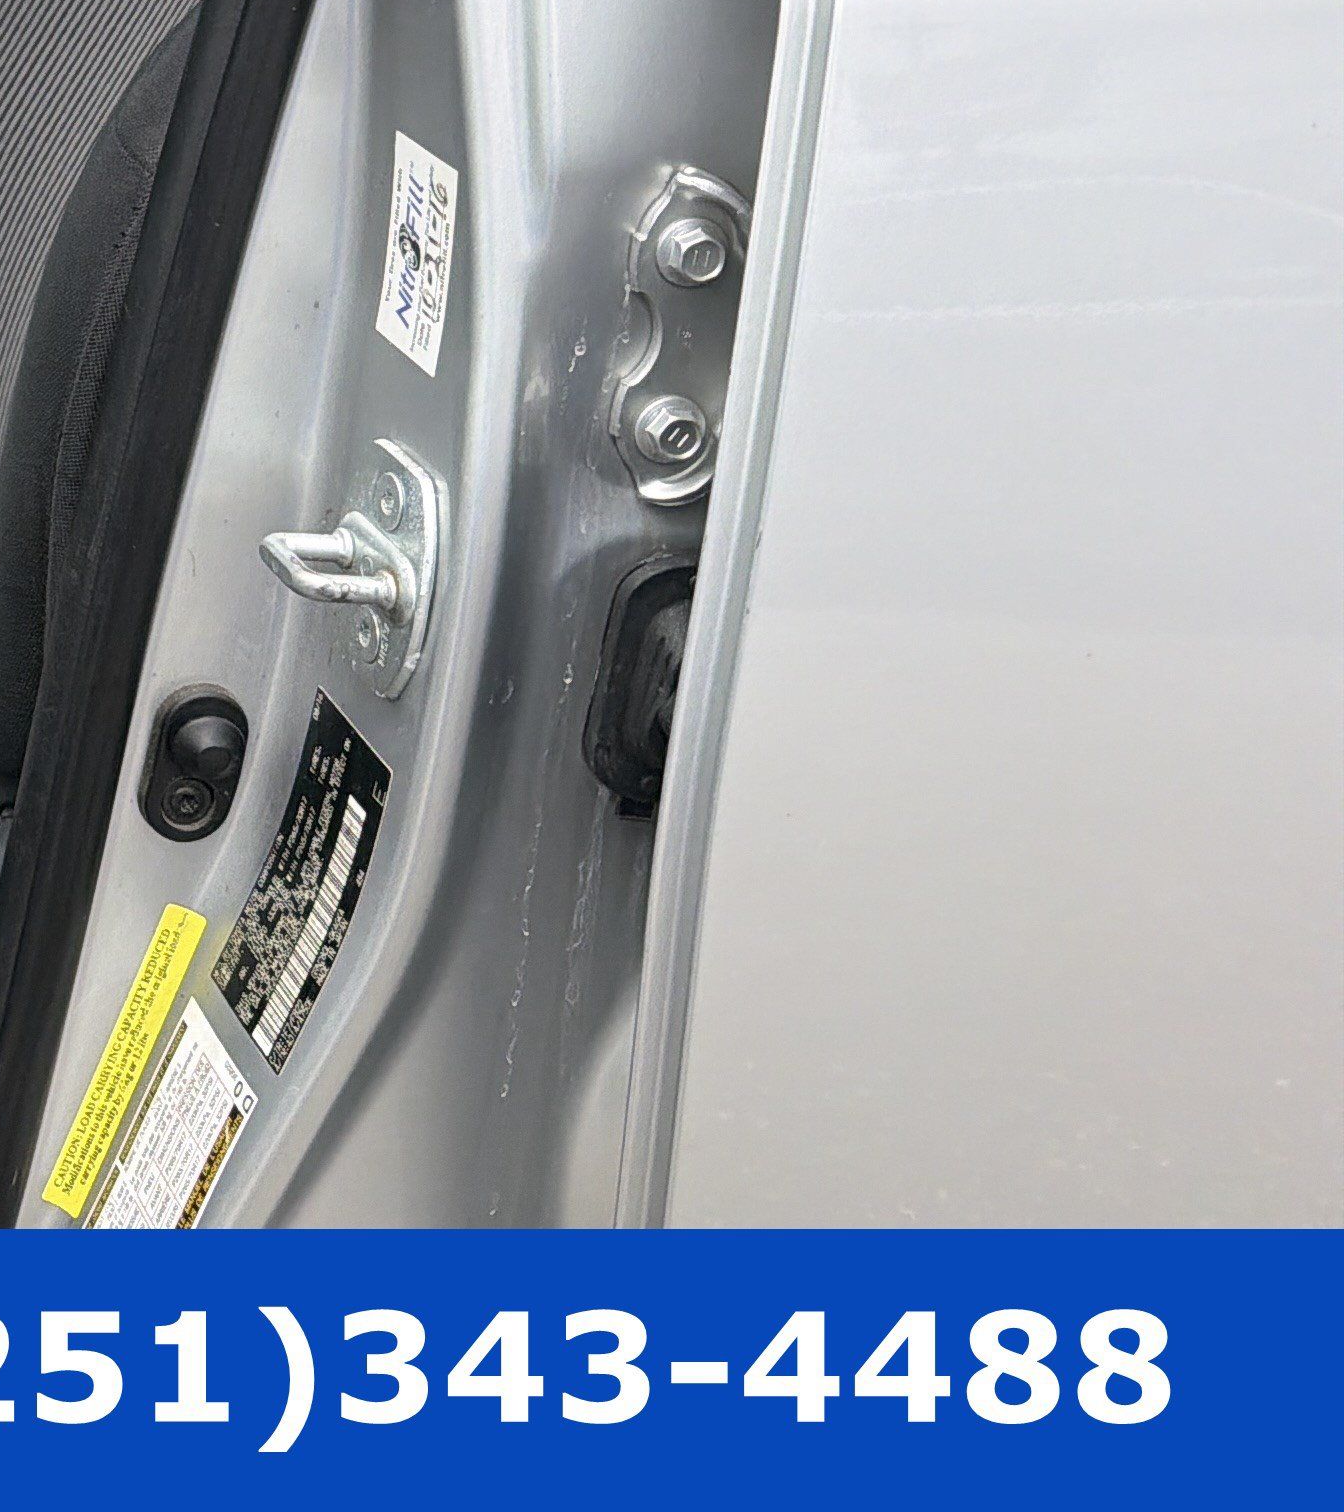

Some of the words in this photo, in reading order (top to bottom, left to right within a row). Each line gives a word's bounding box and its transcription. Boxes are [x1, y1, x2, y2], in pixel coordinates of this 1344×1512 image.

[53, 1134, 81, 1188] CAUTION:
[77, 1103, 97, 1135] LOAD
[90, 1042, 122, 1101] CARRYING
[117, 984, 147, 1042] CAPACITY
[141, 928, 172, 985] REDUCED
[79, 1145, 104, 1186] carrying
[98, 1106, 120, 1146] capacity
[96, 1104, 108, 1125] this
